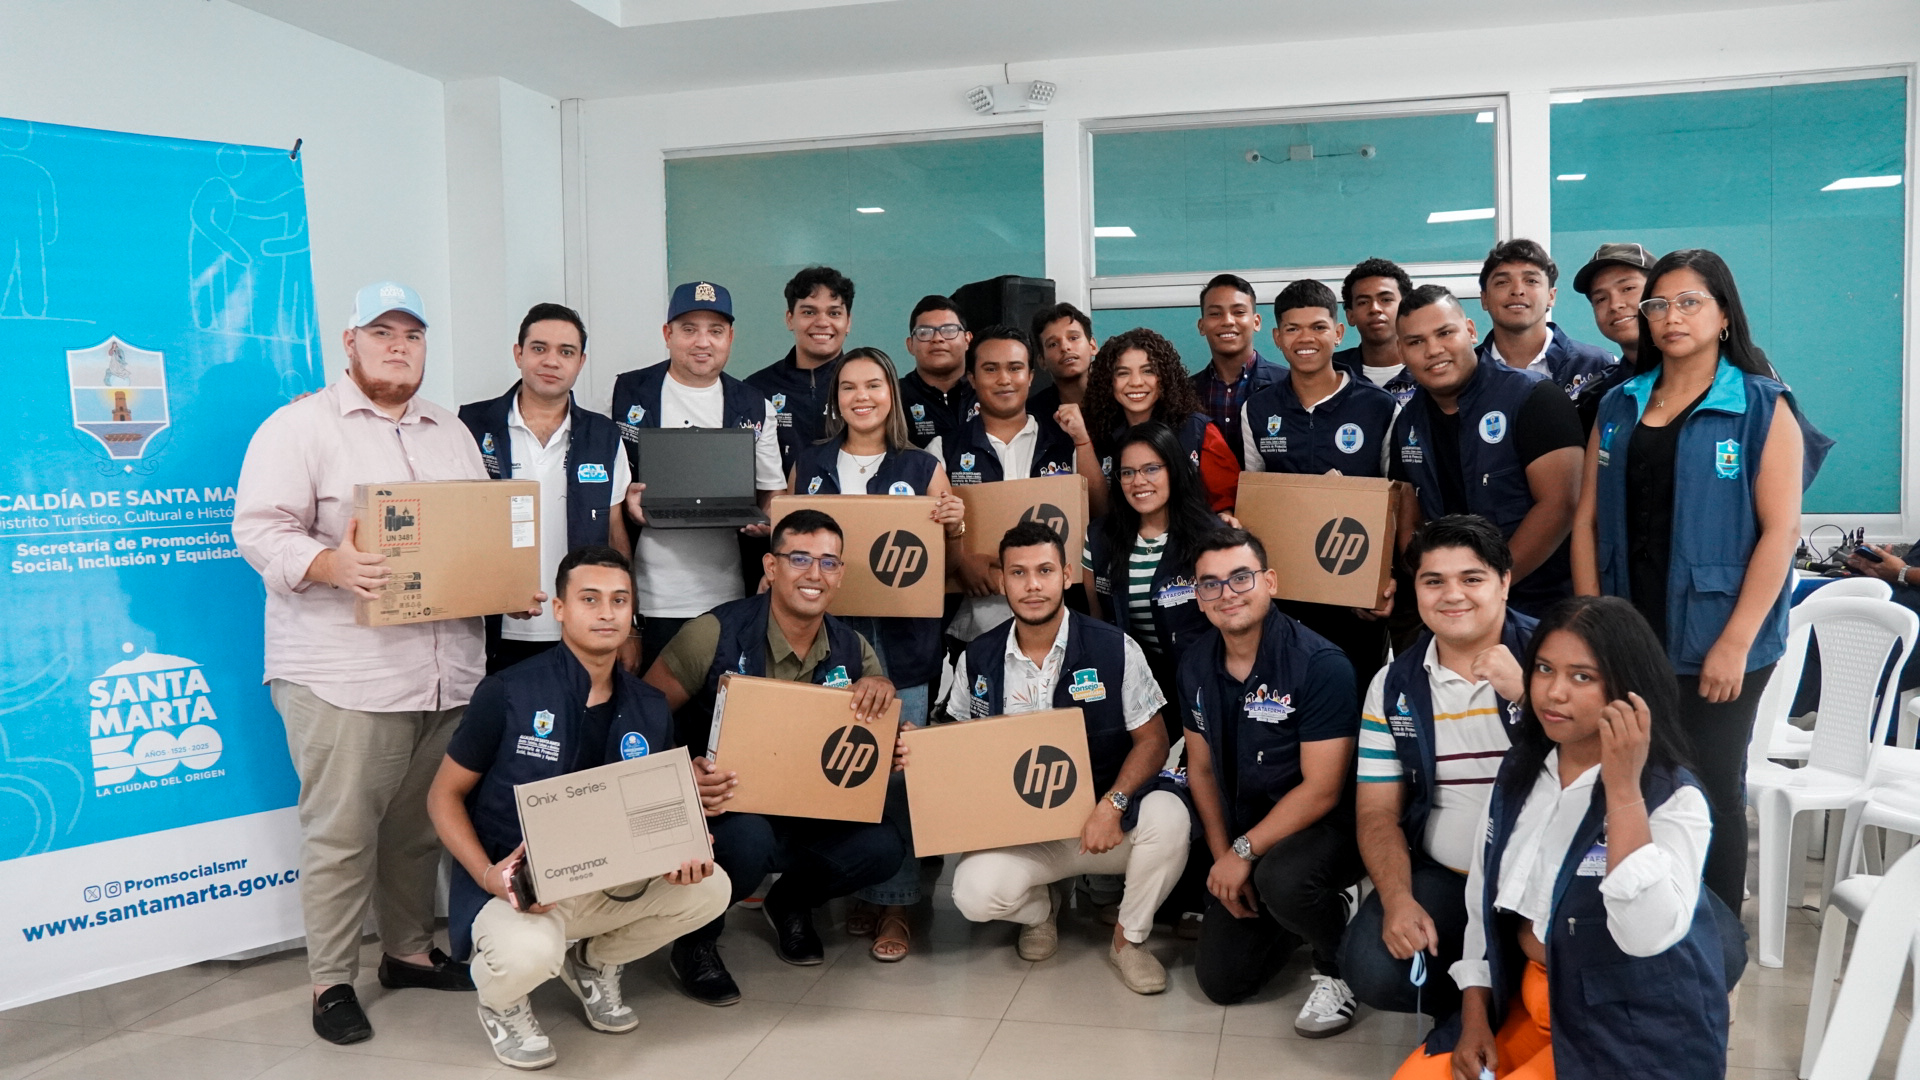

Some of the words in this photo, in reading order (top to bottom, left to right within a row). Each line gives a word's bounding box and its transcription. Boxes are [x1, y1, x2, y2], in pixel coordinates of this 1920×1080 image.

[90, 490, 120, 508] DE
[126, 488, 200, 506] SANTA
[0, 515, 49, 530] istrito
[52, 512, 121, 527] Turístico,
[125, 508, 182, 523] Cultural
[186, 510, 194, 519] e
[17, 539, 110, 556] Secretaría
[115, 537, 136, 551] de
[141, 532, 230, 548] Promoción
[1318, 517, 1367, 575] hp
[12, 557, 73, 574] Social,
[79, 551, 156, 570] Inclusión
[161, 552, 170, 565] y
[874, 530, 925, 588] hp
[88, 669, 212, 708] SANTA
[1070, 682, 1098, 693] Consejo
[90, 696, 218, 738] MARTA
[1250, 706, 1287, 714] PLATAFORMA
[90, 724, 222, 787] 500
[145, 749, 166, 758] AÑOS
[171, 746, 187, 755] 1525
[192, 743, 209, 752] 2025
[823, 725, 877, 788] hp
[96, 787, 111, 798] LA
[114, 780, 158, 795] CIUDAD
[161, 775, 182, 787] DEL
[185, 769, 225, 783] ORIGEN
[1018, 745, 1073, 809] hp
[526, 792, 558, 808] Onix
[565, 782, 607, 798] Series
[124, 858, 248, 894] Promsocialsmr
[544, 857, 608, 880] Compumax
[22, 868, 300, 942] www.santamarta.gov.c
